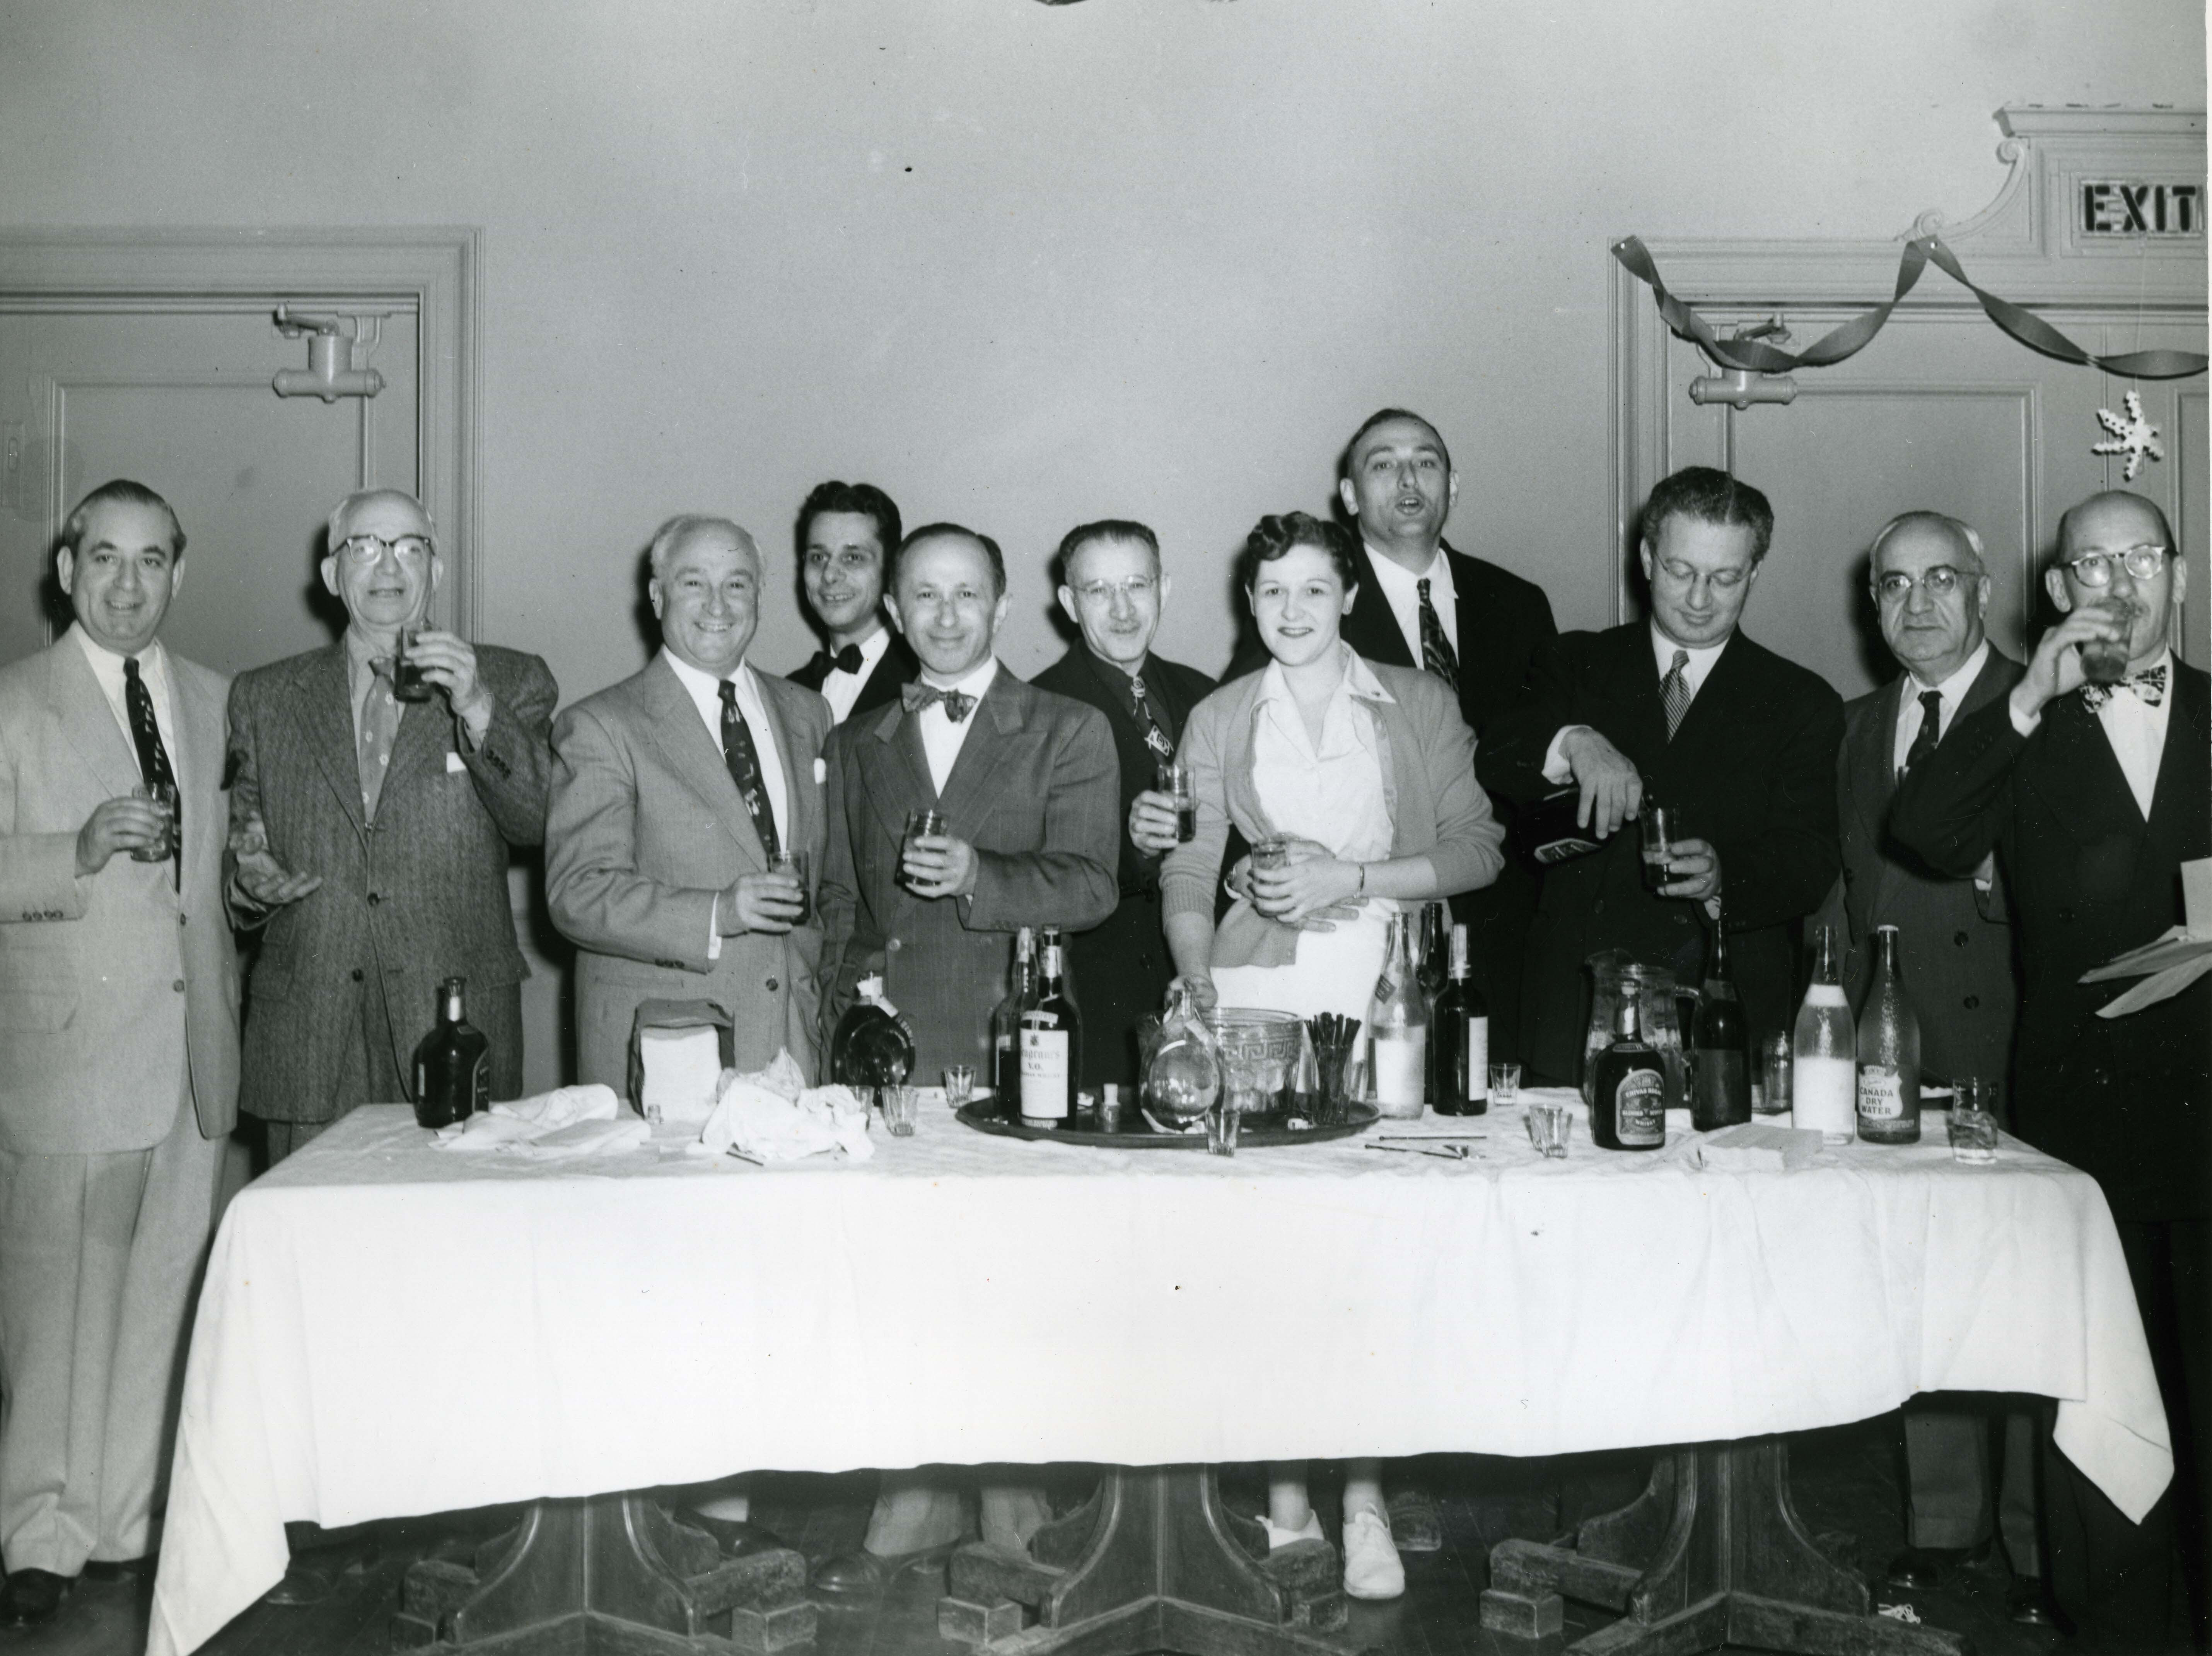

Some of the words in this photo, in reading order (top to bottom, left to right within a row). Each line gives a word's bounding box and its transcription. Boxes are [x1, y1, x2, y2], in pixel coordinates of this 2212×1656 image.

[2085, 185, 2196, 231] EXIT
[1625, 1087, 1647, 1098] CHIVAS
[1860, 1087, 1893, 1097] CANADA
[1866, 1097, 1883, 1105] DRY
[1861, 1105, 1891, 1115] WATER
